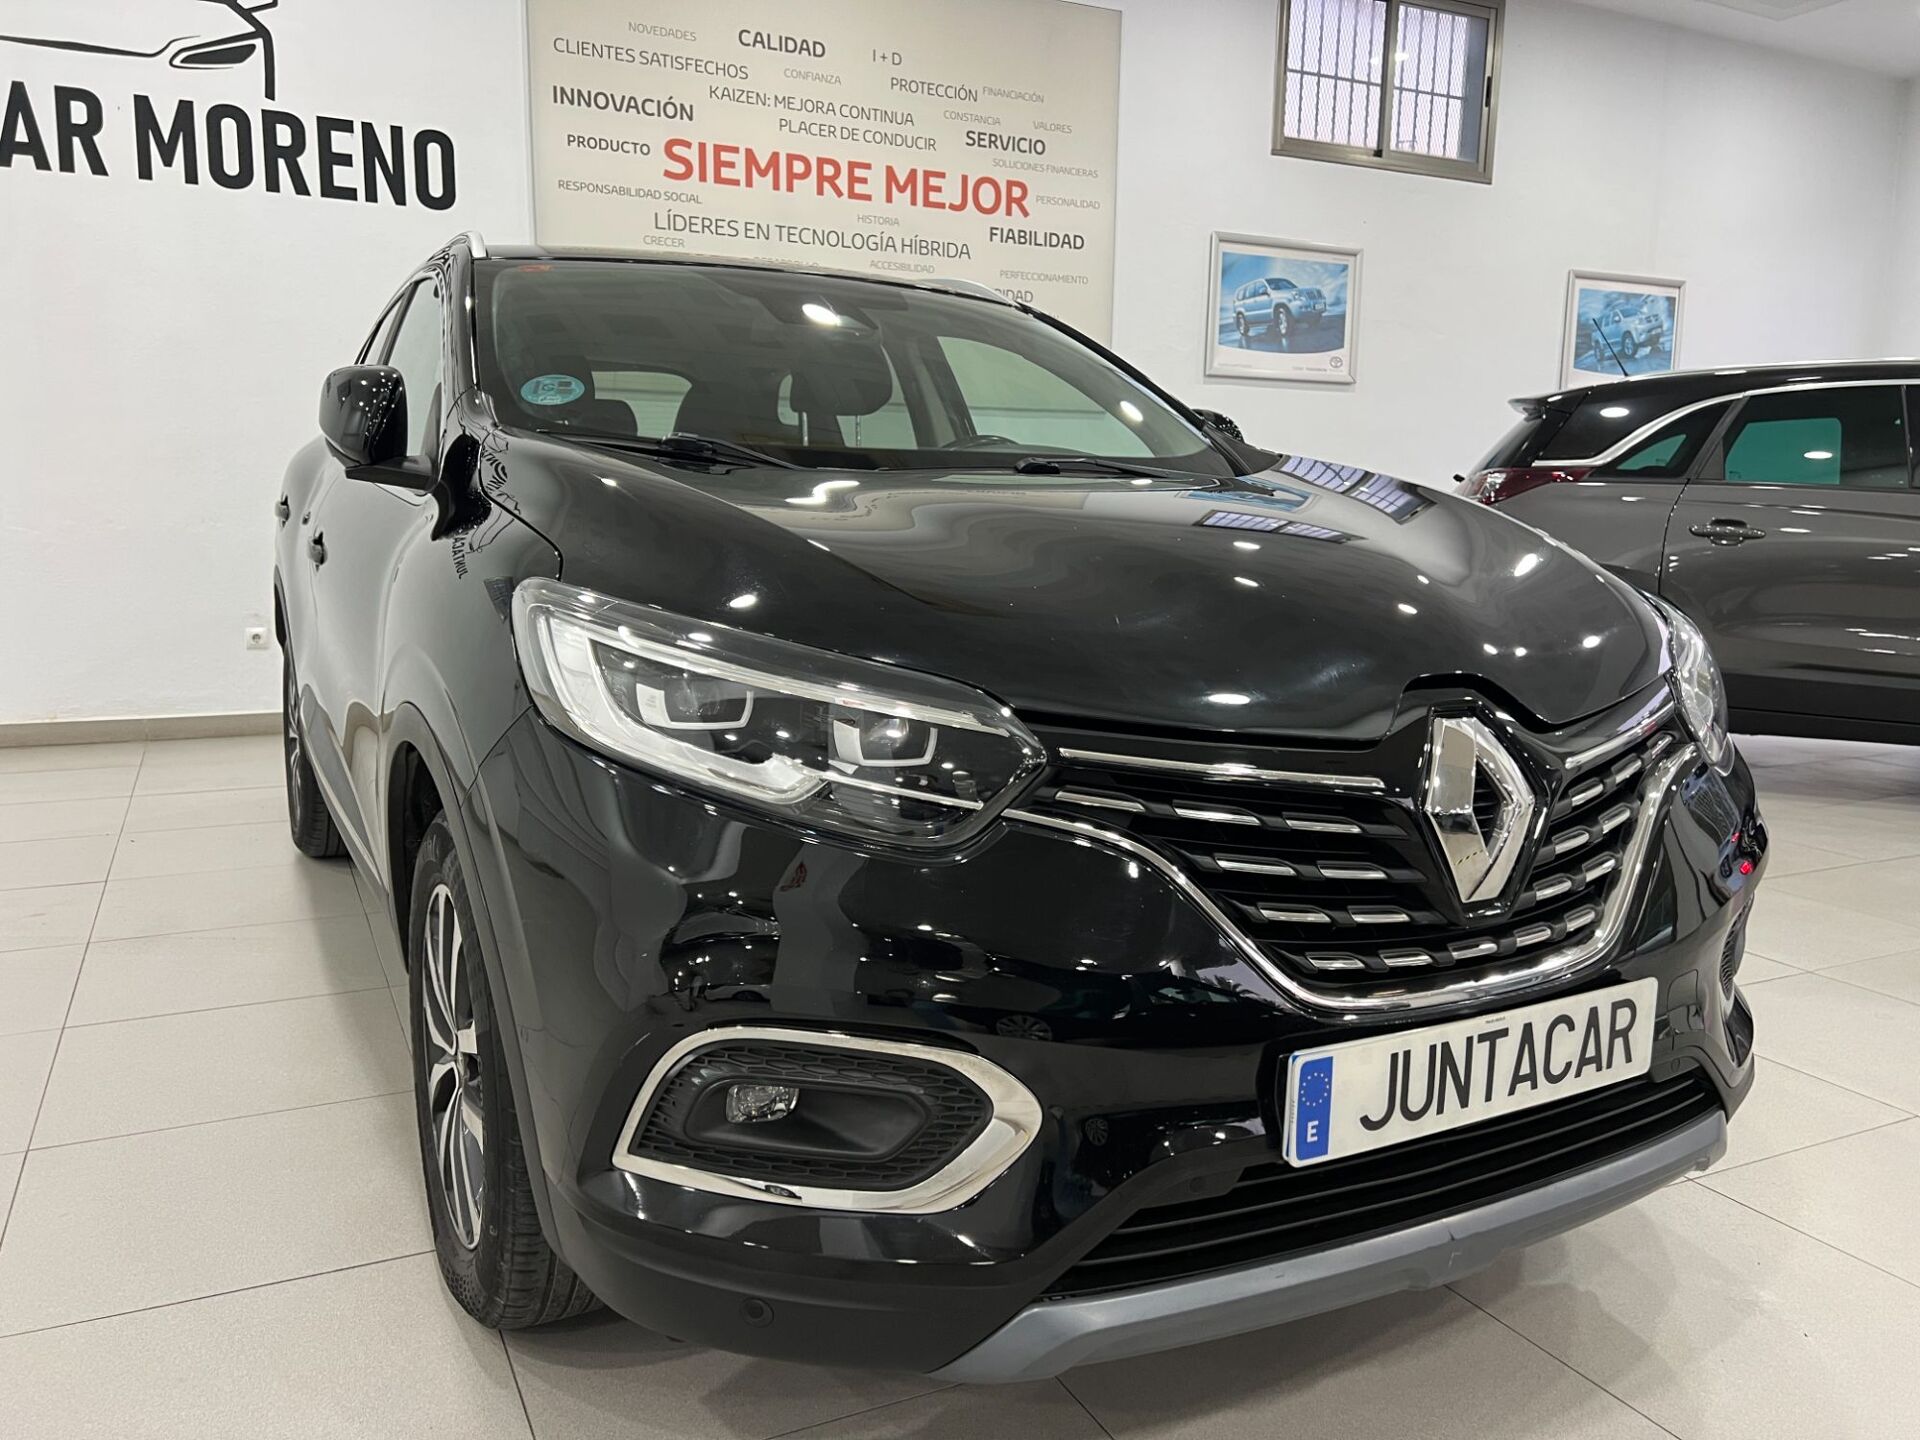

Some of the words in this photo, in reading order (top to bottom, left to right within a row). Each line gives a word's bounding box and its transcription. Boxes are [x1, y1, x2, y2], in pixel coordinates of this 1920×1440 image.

[628, 21, 697, 42] NOVEDADES
[738, 29, 826, 59] CALIDAD
[553, 37, 636, 63] CLIENTES
[639, 50, 749, 80] SATISFECHOS
[892, 52, 903, 66] D
[783, 67, 842, 86] CONFIANZA
[890, 77, 978, 102] PROTECCIÓN
[982, 86, 1045, 103] FINANCIACIÓN
[552, 85, 694, 122] INNOVACIÓN
[709, 85, 771, 107] KAIZEN:
[774, 94, 837, 116] MEJORA
[839, 103, 915, 126] CONTINUA
[943, 109, 1001, 126] CONSTANCIA
[1032, 120, 1073, 134] VALORES
[567, 134, 651, 156] PRODUCTO
[779, 118, 837, 139] PLACER
[840, 126, 860, 142] DE
[863, 129, 937, 151] CONDUCIR
[965, 130, 1046, 156] SERVICIO
[133, 94, 457, 211] MORENO
[663, 138, 873, 201] SIEMPRE
[885, 165, 1030, 218] MEJOR
[992, 157, 1045, 174] SOLUCIONES
[1046, 162, 1099, 178] FINANCIERAS
[557, 179, 662, 200] RESPONSABILIDAD
[663, 190, 703, 204] SOCIAL
[1035, 195, 1101, 210] PERSONALIDAD
[857, 214, 900, 227] HISTORIA
[643, 234, 685, 248] CRECER
[654, 209, 740, 238] LÍDERES
[744, 221, 770, 241] EN
[774, 224, 898, 253] TECNOLOGÍA
[901, 235, 971, 260] HÍBRIDA
[989, 226, 1085, 250] FIABILIDAD
[870, 259, 935, 274] ACCESIBILIDAD
[1000, 270, 1089, 285] PERFECCIONAMIENTO
[1359, 998, 1637, 1132] JUNTACAR
[1306, 1119, 1319, 1143] E
